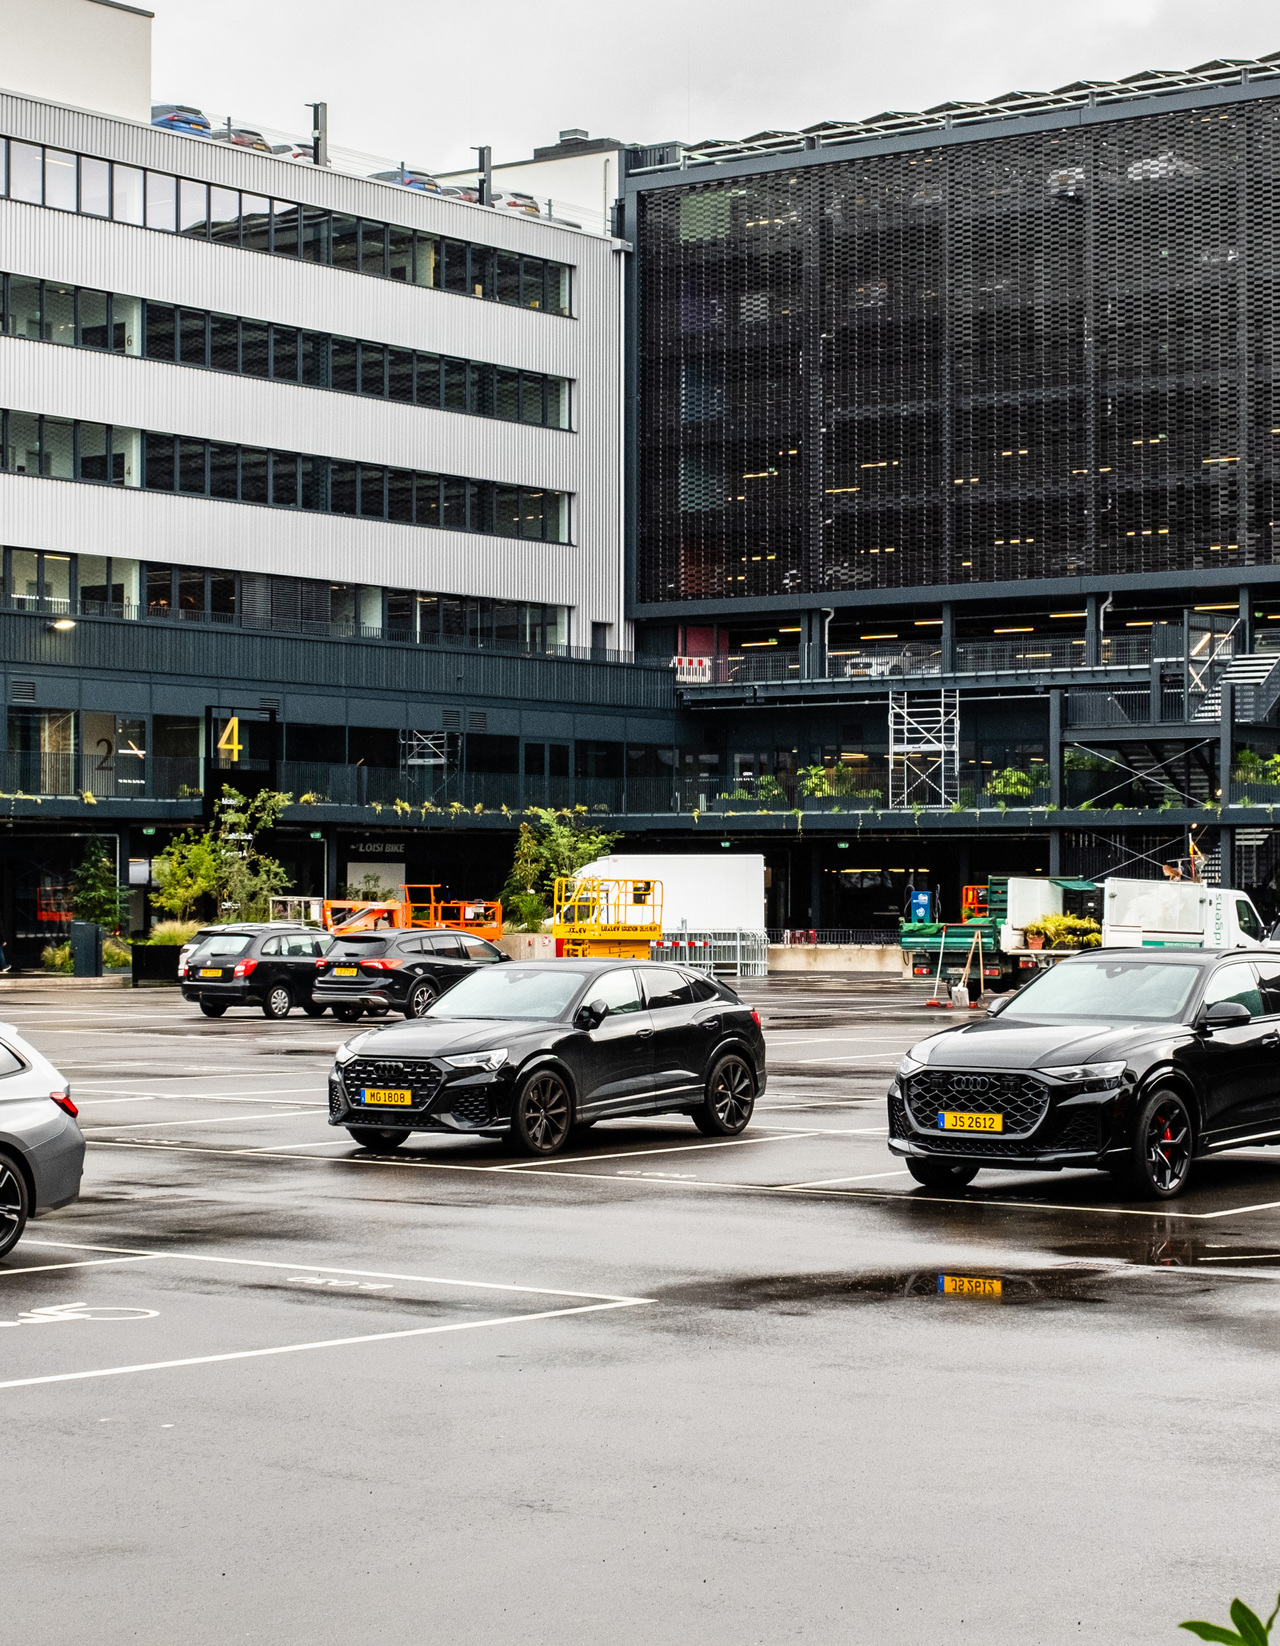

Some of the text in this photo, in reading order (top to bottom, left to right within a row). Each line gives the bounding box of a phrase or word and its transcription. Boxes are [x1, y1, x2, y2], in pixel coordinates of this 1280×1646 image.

[126, 334, 133, 347] 6
[125, 465, 132, 478] 4
[217, 716, 243, 762] 4
[95, 738, 114, 772] 2
[358, 843, 405, 853] LOISI BIKE
[370, 1091, 406, 1103] MG 1808
[951, 1115, 965, 1128] JS
[967, 1116, 995, 1129] 2612
